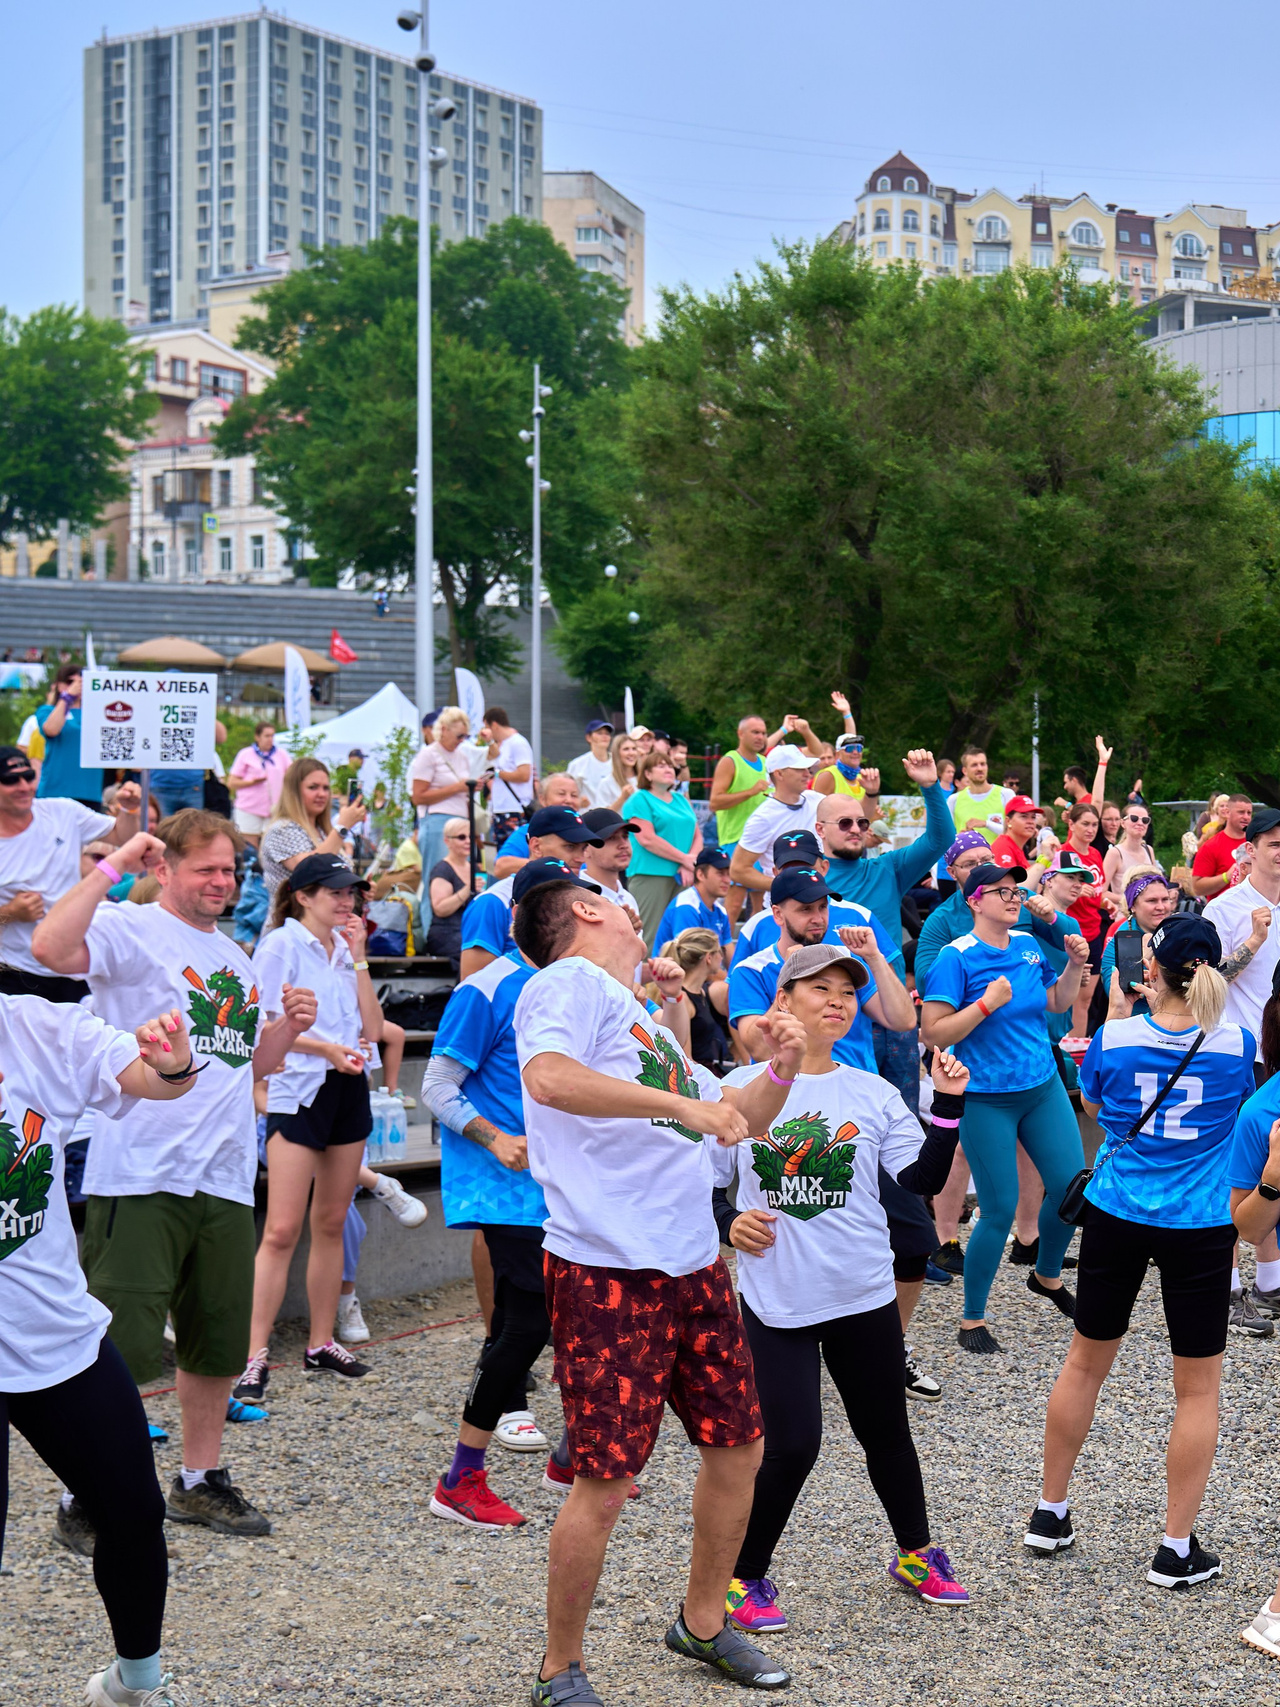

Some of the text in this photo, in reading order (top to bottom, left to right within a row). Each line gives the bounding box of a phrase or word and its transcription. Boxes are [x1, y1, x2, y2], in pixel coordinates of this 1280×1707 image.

[91, 678, 210, 694] БАНКА ХЛЕБА
[1134, 1072, 1204, 1141] 12
[767, 1190, 844, 1208] ДЖАНГЛ
